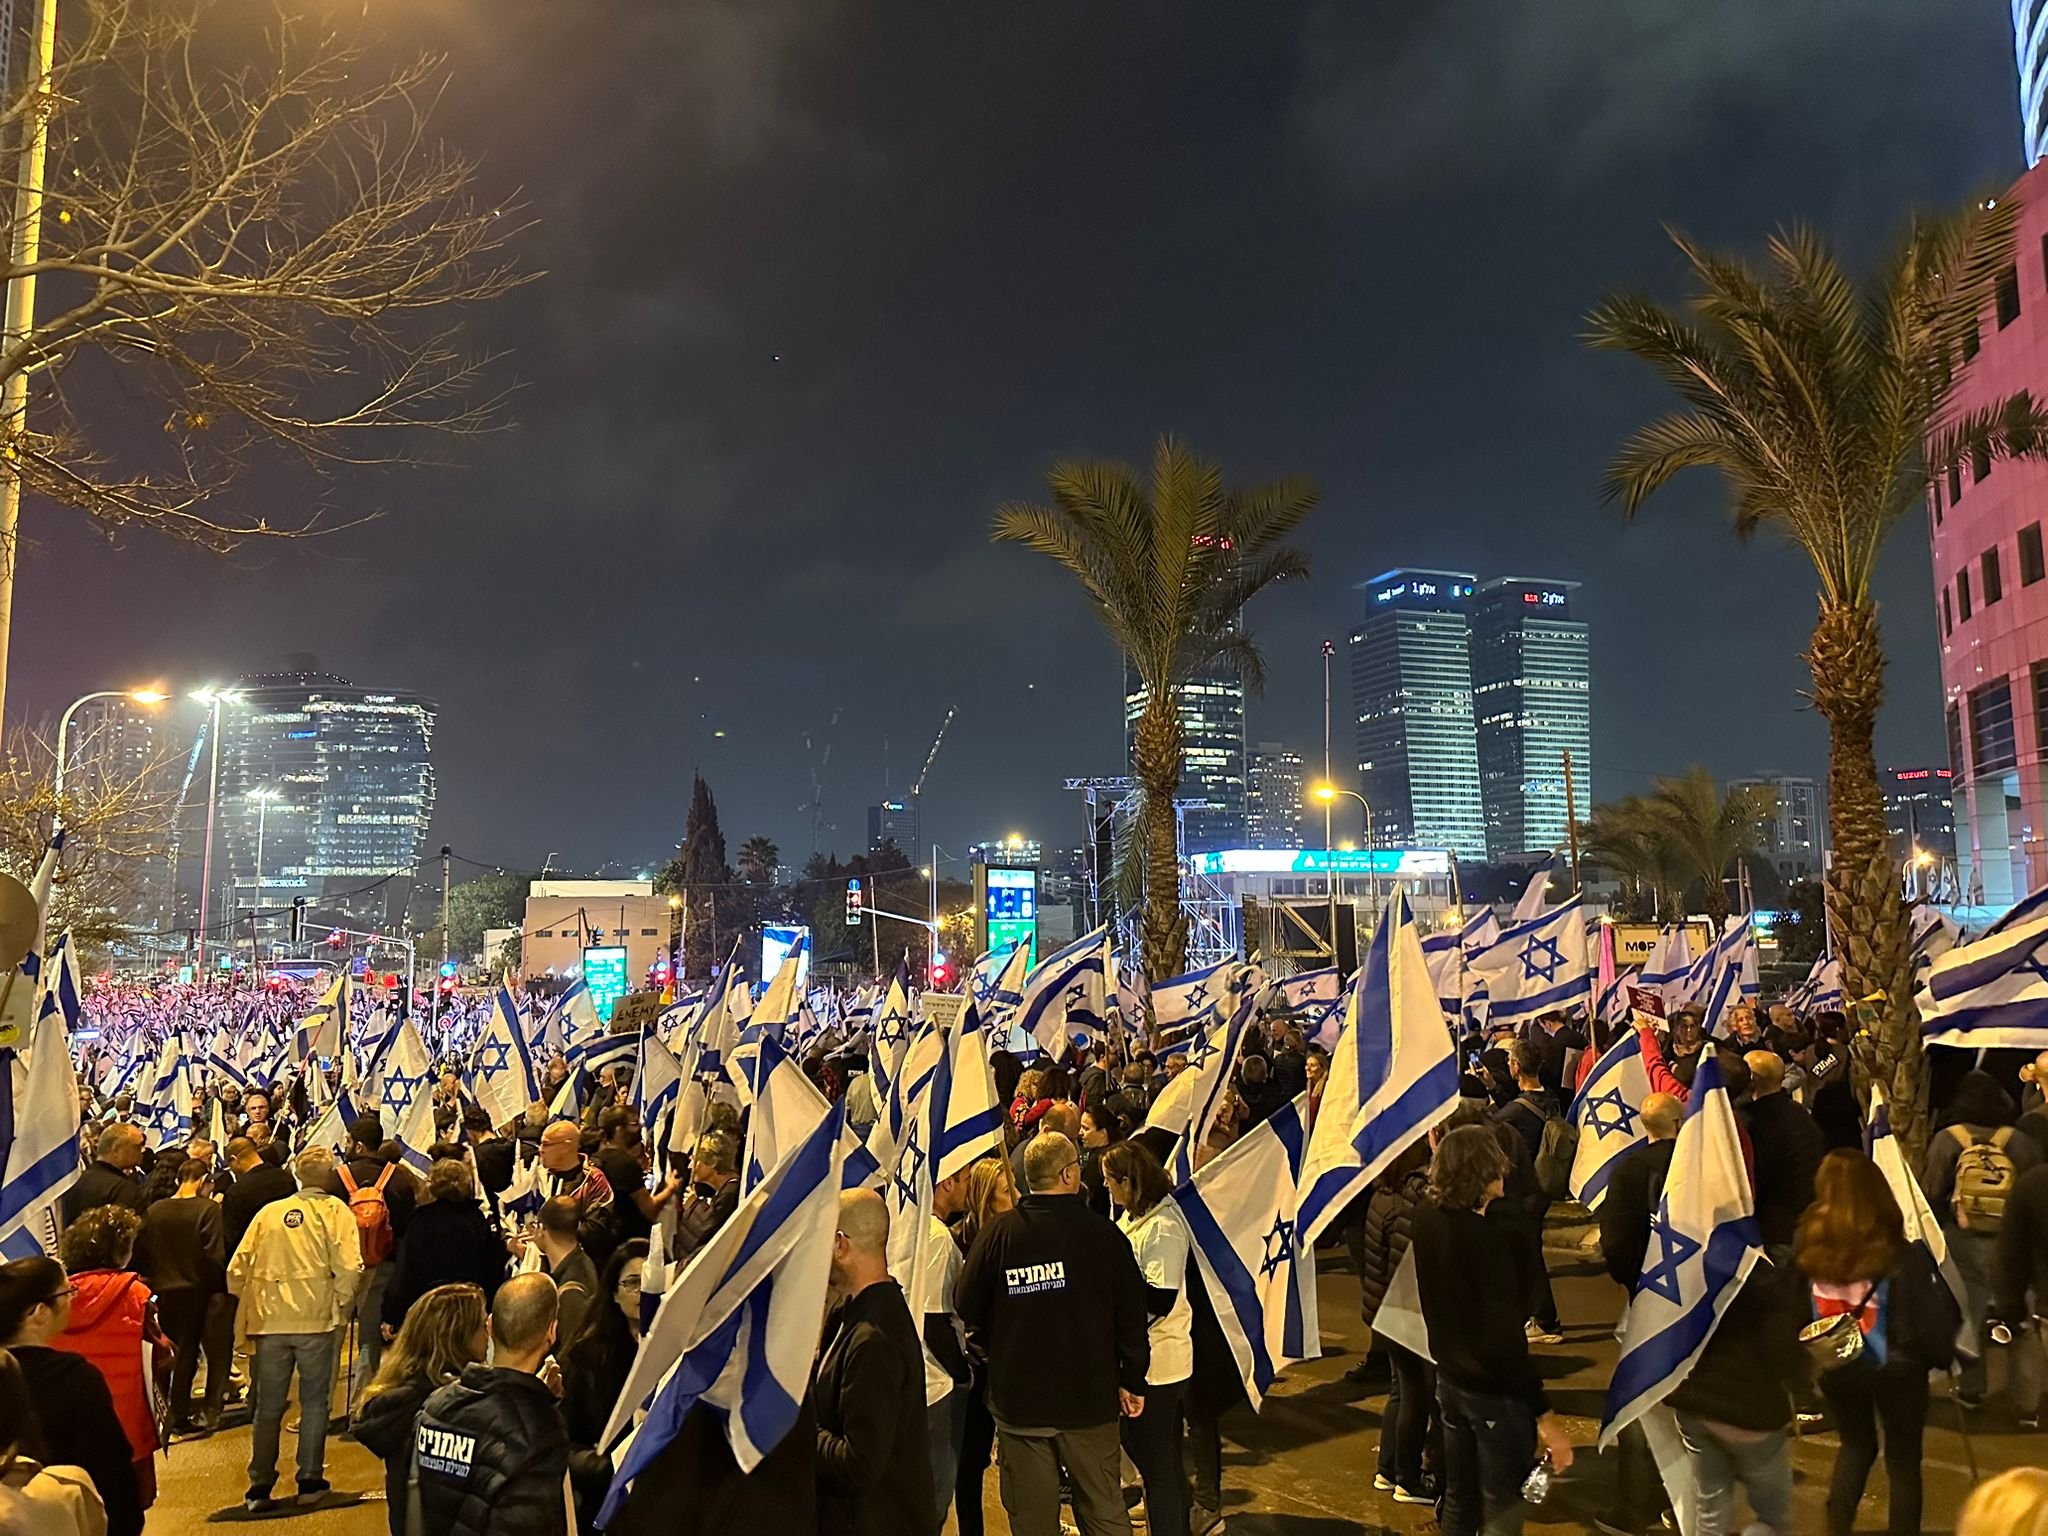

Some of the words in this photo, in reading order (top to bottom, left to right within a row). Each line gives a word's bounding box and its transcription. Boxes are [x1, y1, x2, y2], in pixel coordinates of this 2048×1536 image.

[1897, 770, 1929, 780] SUZUKI
[616, 1004, 656, 1021] ENEMY
[1005, 1261, 1065, 1287] נאמנים
[1008, 1283, 1041, 1296] העצמאות
[1041, 1279, 1066, 1291] למגילת
[418, 1425, 476, 1465] נאמנים
